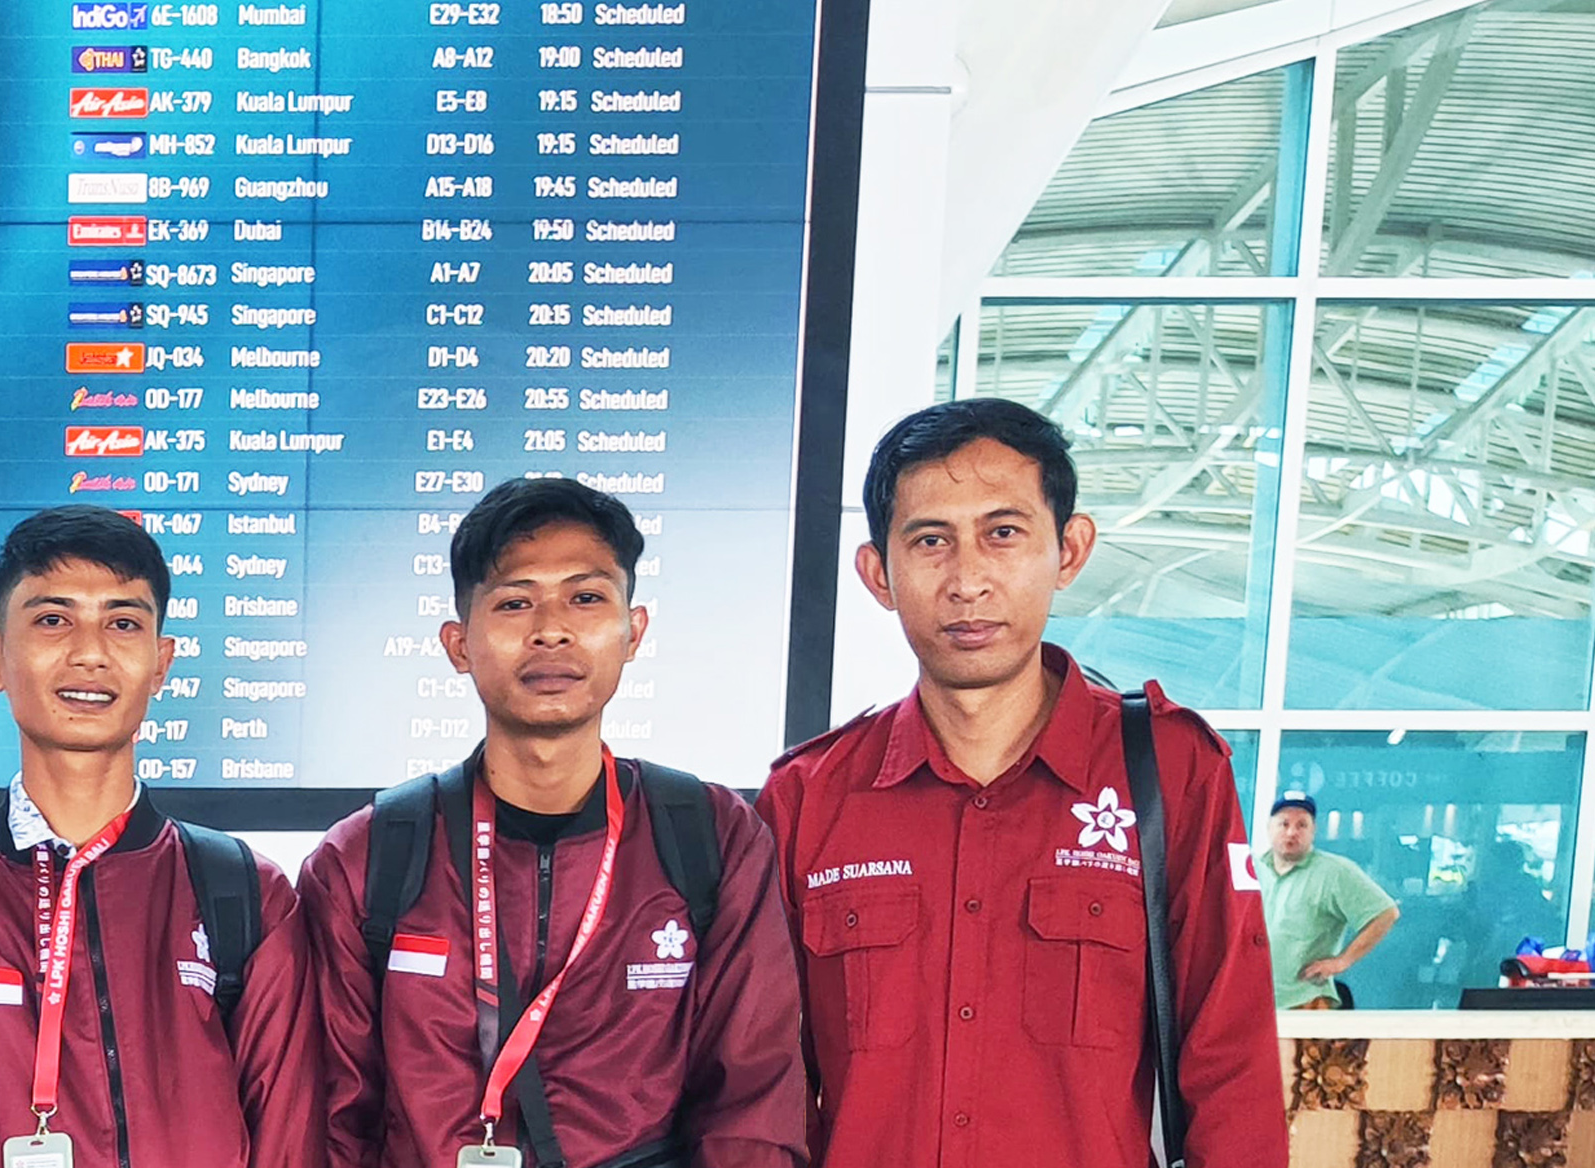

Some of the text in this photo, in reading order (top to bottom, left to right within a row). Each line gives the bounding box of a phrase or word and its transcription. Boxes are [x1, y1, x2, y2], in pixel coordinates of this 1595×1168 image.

[72, 4, 128, 28] IndiGo
[238, 4, 306, 26] Mumbai
[429, 2, 501, 26] E29-E32
[594, 3, 686, 25] Scheduled
[94, 51, 124, 68] THAI
[149, 47, 214, 70] TG-440
[237, 47, 312, 73] Bangkok
[432, 46, 494, 69] A8-A12
[538, 45, 581, 68] 19:00
[592, 46, 683, 69] Scheduled
[148, 90, 213, 113] AK-379
[236, 90, 354, 116] Kuala Lumpur
[436, 89, 488, 112] E5-E8
[538, 89, 578, 112] 19:15
[149, 133, 216, 156] MH-852
[235, 133, 353, 159] Kuala Lumpur
[426, 132, 495, 155] D13-D16
[536, 132, 576, 155] 19:15
[147, 176, 210, 199] 8B-969
[234, 176, 329, 202] Guangzhou
[533, 175, 576, 198] 19:45
[587, 176, 678, 199] Scheduled
[147, 219, 209, 241] EK-369
[233, 219, 282, 241] Dubai
[532, 218, 575, 241] 19:50
[145, 264, 217, 289] SQ-8673
[231, 261, 316, 288] Singapore
[430, 261, 481, 283] A1-A7
[528, 261, 574, 284] 20:05
[146, 304, 209, 329] SQ-945
[231, 304, 317, 330] Singapore
[426, 303, 484, 326] C1-C12
[528, 303, 571, 326] 20:15
[582, 304, 672, 326] Scheduled
[145, 346, 205, 371] JQ-034
[231, 346, 321, 368] Melbourne
[427, 346, 480, 368] D1-D4
[525, 346, 571, 368] 20:20
[144, 388, 204, 410] OD-177
[230, 388, 320, 410] Melbourne
[417, 387, 487, 410] E23-E26
[524, 387, 570, 410] 20:55
[142, 429, 206, 451] AK-375
[229, 429, 345, 454] Kuala Lumpur
[426, 429, 474, 451] E1-E4
[524, 429, 566, 451] 21:05
[806, 859, 913, 889] MADE SUARSANA
[49, 838, 111, 988] LPK HOSHI GAKUEN BALI
